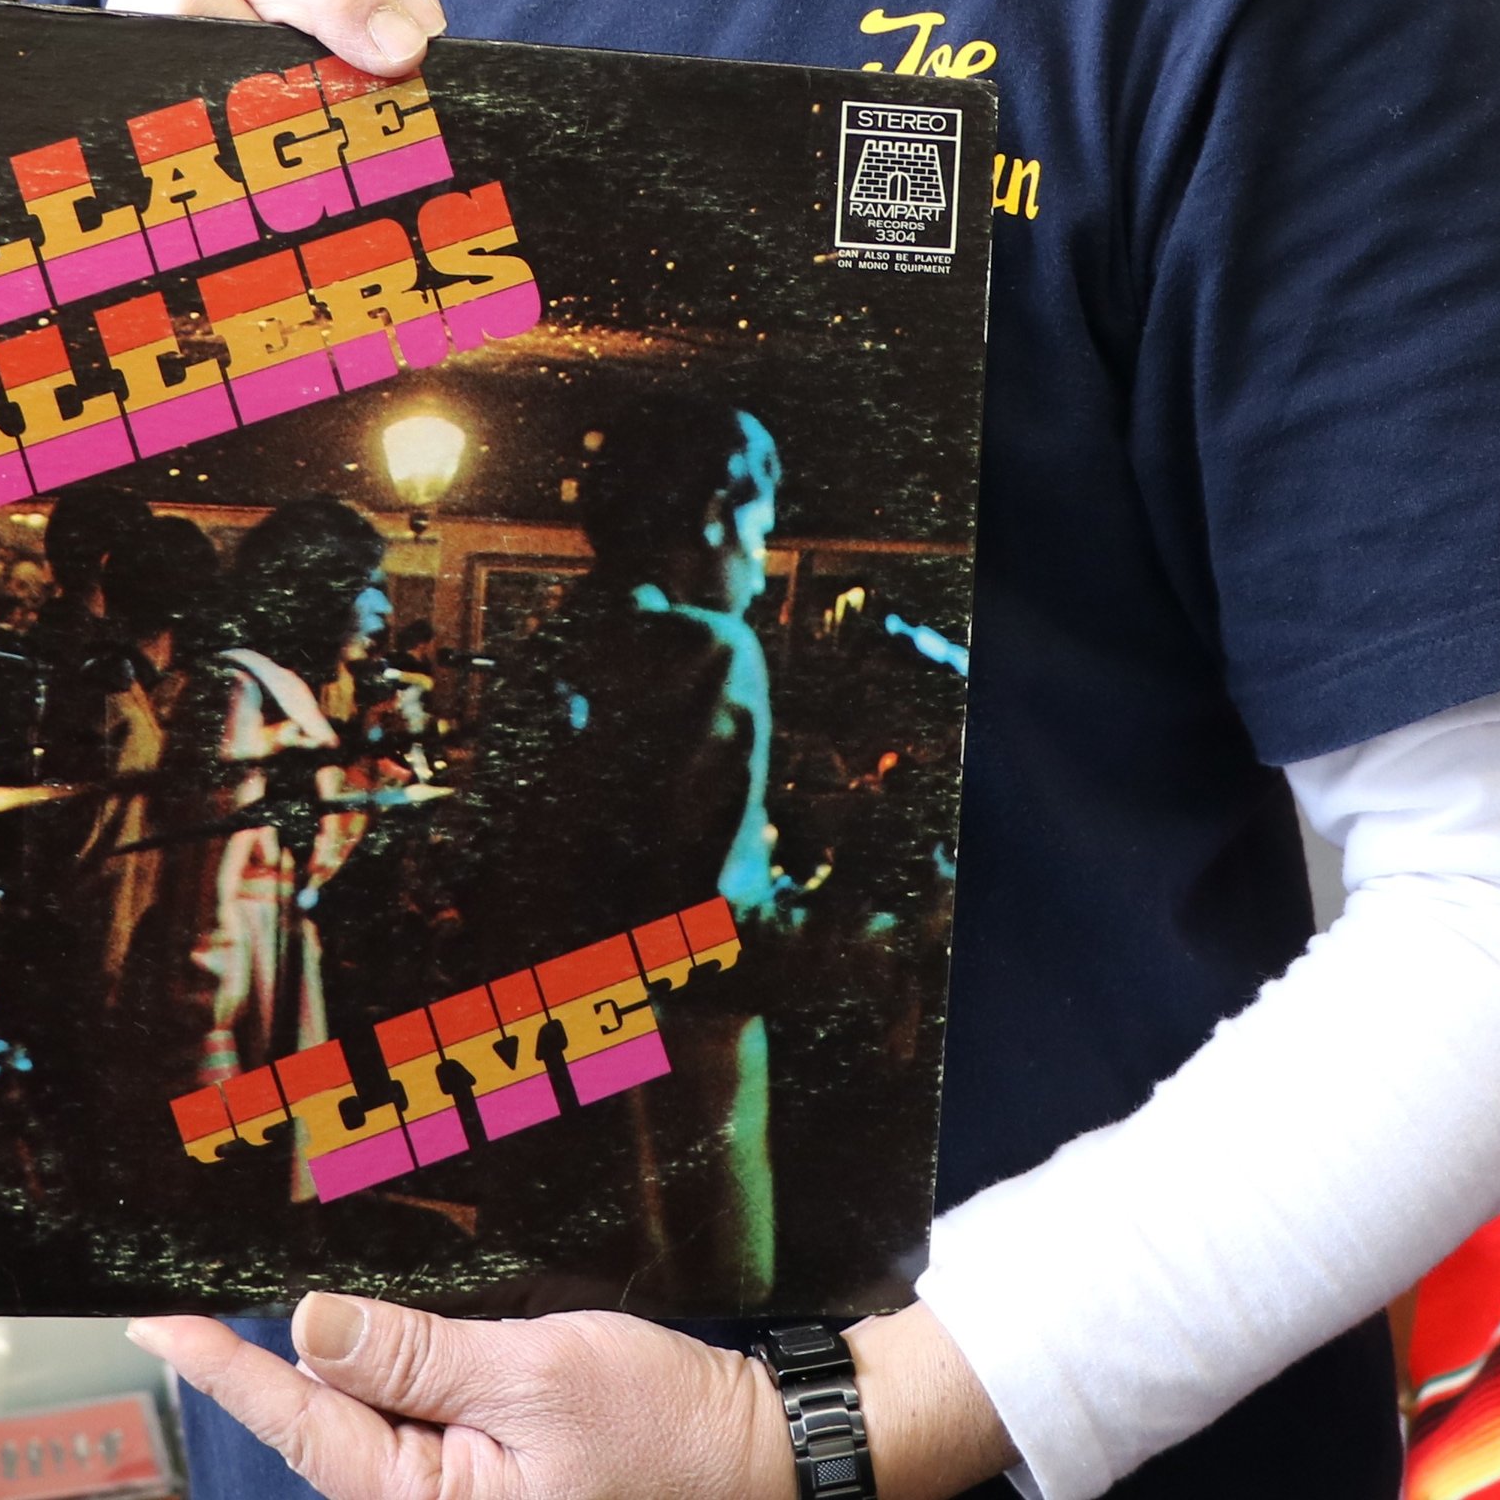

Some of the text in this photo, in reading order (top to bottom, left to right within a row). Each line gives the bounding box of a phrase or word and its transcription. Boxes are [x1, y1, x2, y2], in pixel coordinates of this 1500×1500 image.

[857, 109, 947, 133] STEREO
[848, 202, 946, 221] RAMPART
[867, 219, 925, 231] RECORDS
[875, 230, 916, 243] 3304
[837, 249, 952, 263] CAN ALSO BE PLAYED
[837, 260, 951, 274] ON MONO EQUIPMENT
